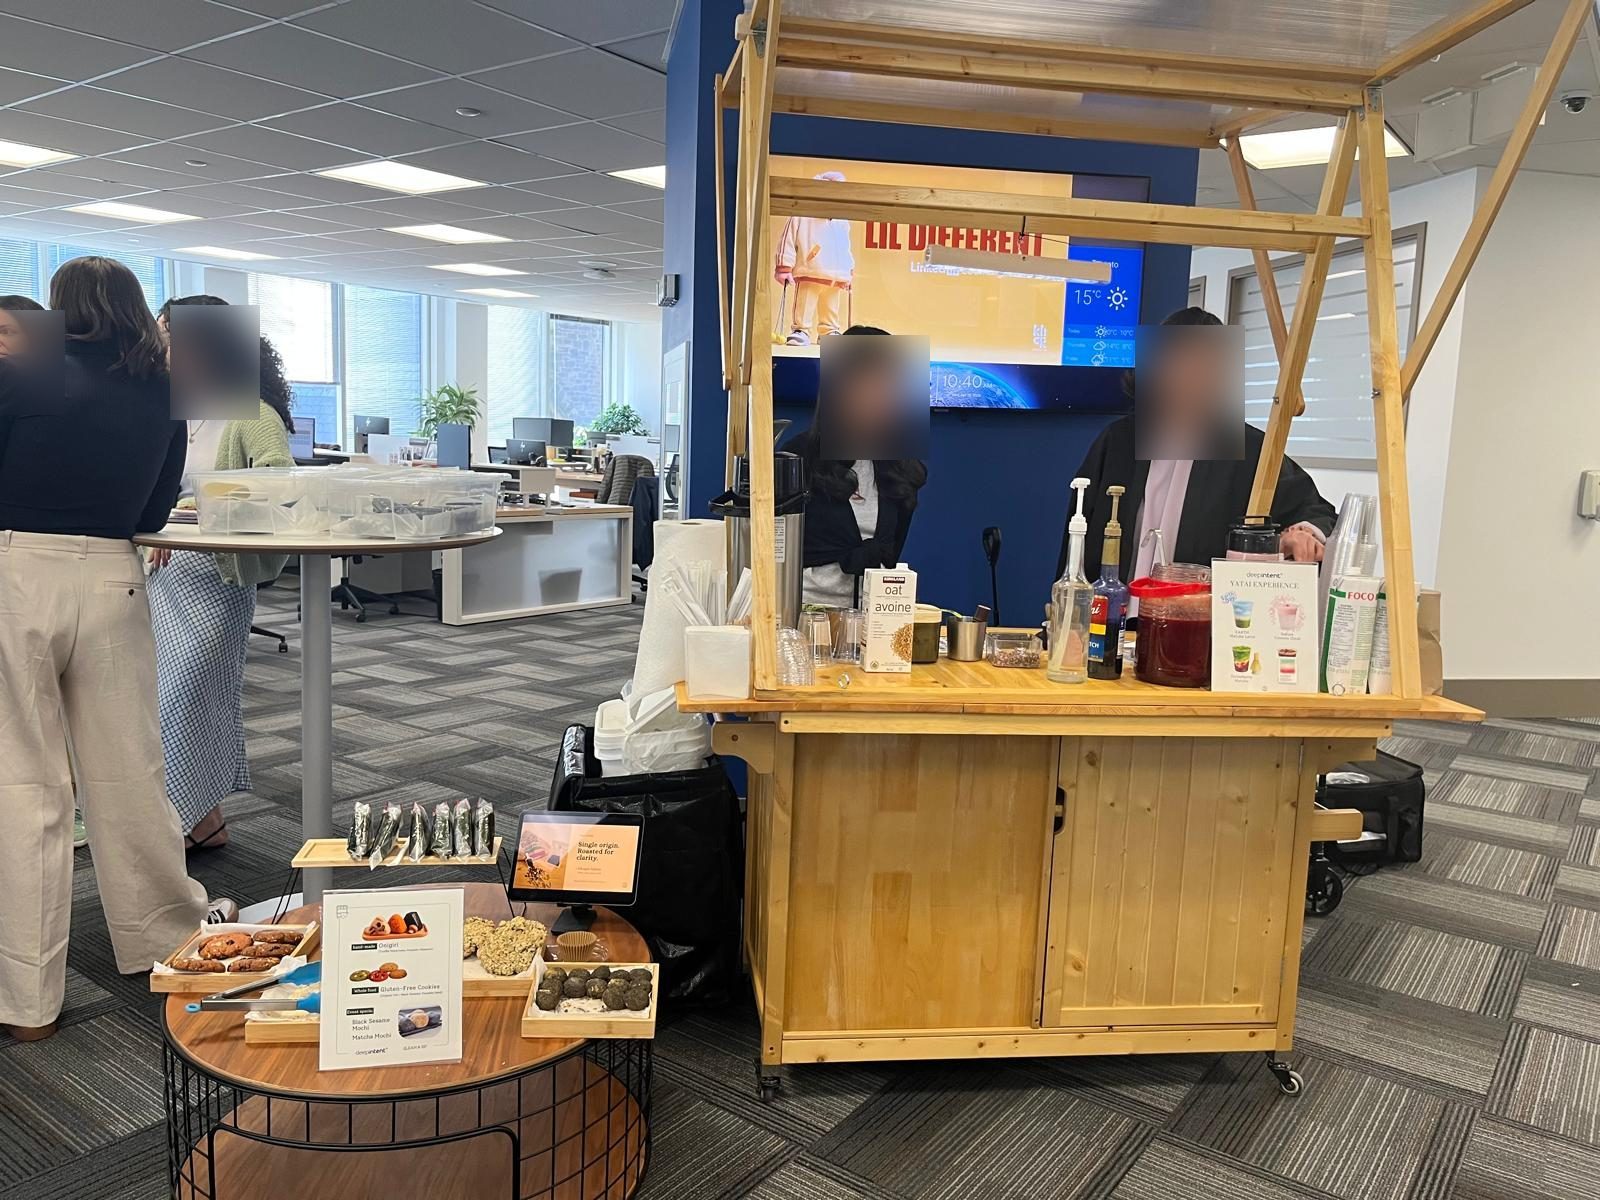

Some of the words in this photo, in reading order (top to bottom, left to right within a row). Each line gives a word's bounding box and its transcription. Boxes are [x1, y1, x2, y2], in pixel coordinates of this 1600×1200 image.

[865, 221, 901, 250] LIL
[943, 374, 982, 388] 10:40
[1230, 580, 1251, 588] YATAI
[1253, 581, 1299, 589] EXPERIENCE
[885, 585, 902, 595] oat
[1347, 592, 1375, 601] FOCO
[875, 601, 911, 612] avoine
